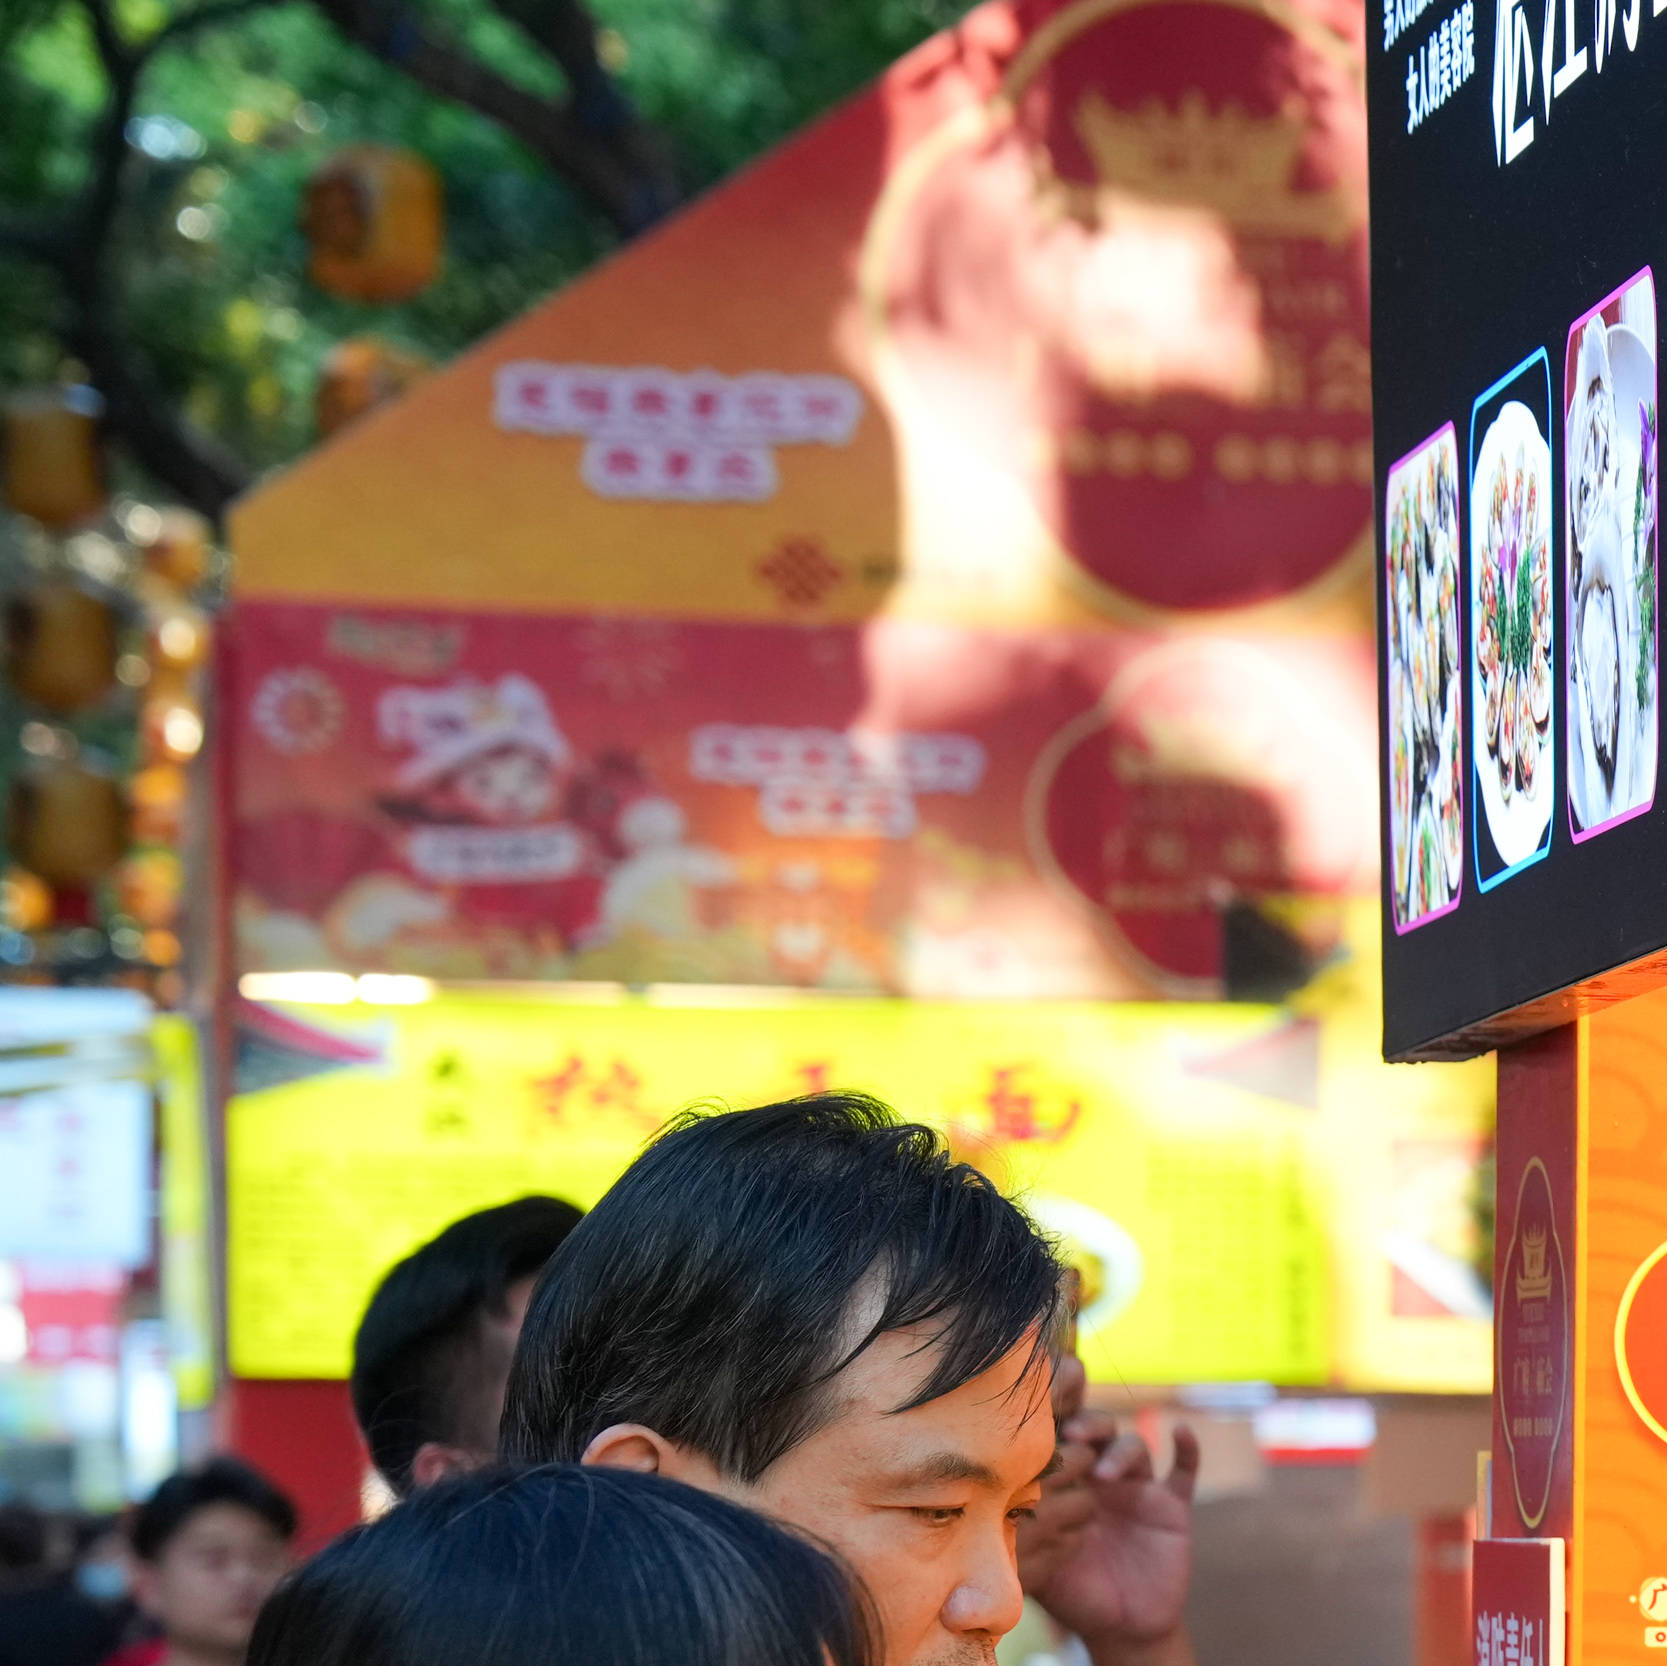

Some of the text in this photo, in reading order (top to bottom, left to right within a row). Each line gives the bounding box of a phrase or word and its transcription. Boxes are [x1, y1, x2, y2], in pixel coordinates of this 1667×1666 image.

[1406, 0, 1475, 134] 女人的美容院
